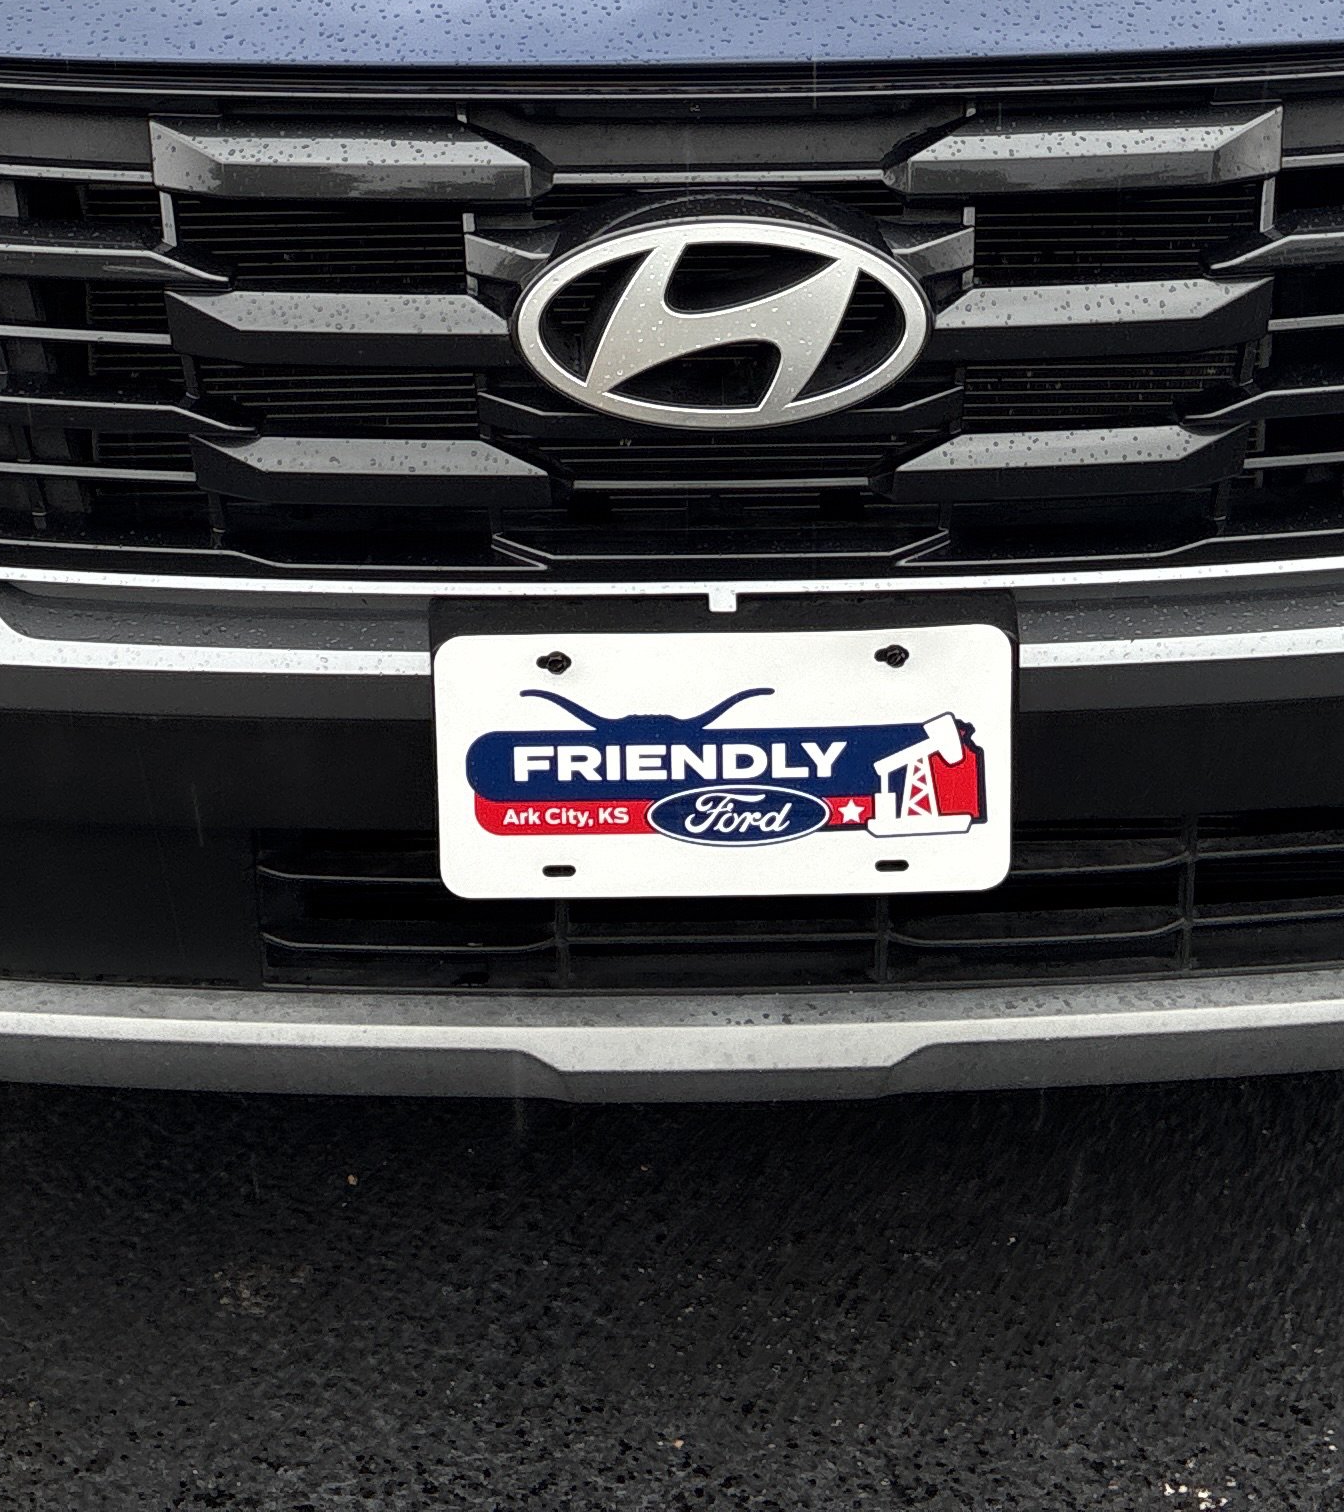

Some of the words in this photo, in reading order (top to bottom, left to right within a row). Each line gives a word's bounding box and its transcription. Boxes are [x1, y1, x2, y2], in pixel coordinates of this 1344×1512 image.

[513, 741, 848, 782] FRIENDLY
[503, 807, 540, 826] Ark
[544, 806, 594, 828] City,
[598, 806, 630, 825] KS
[684, 792, 792, 834] Ford
